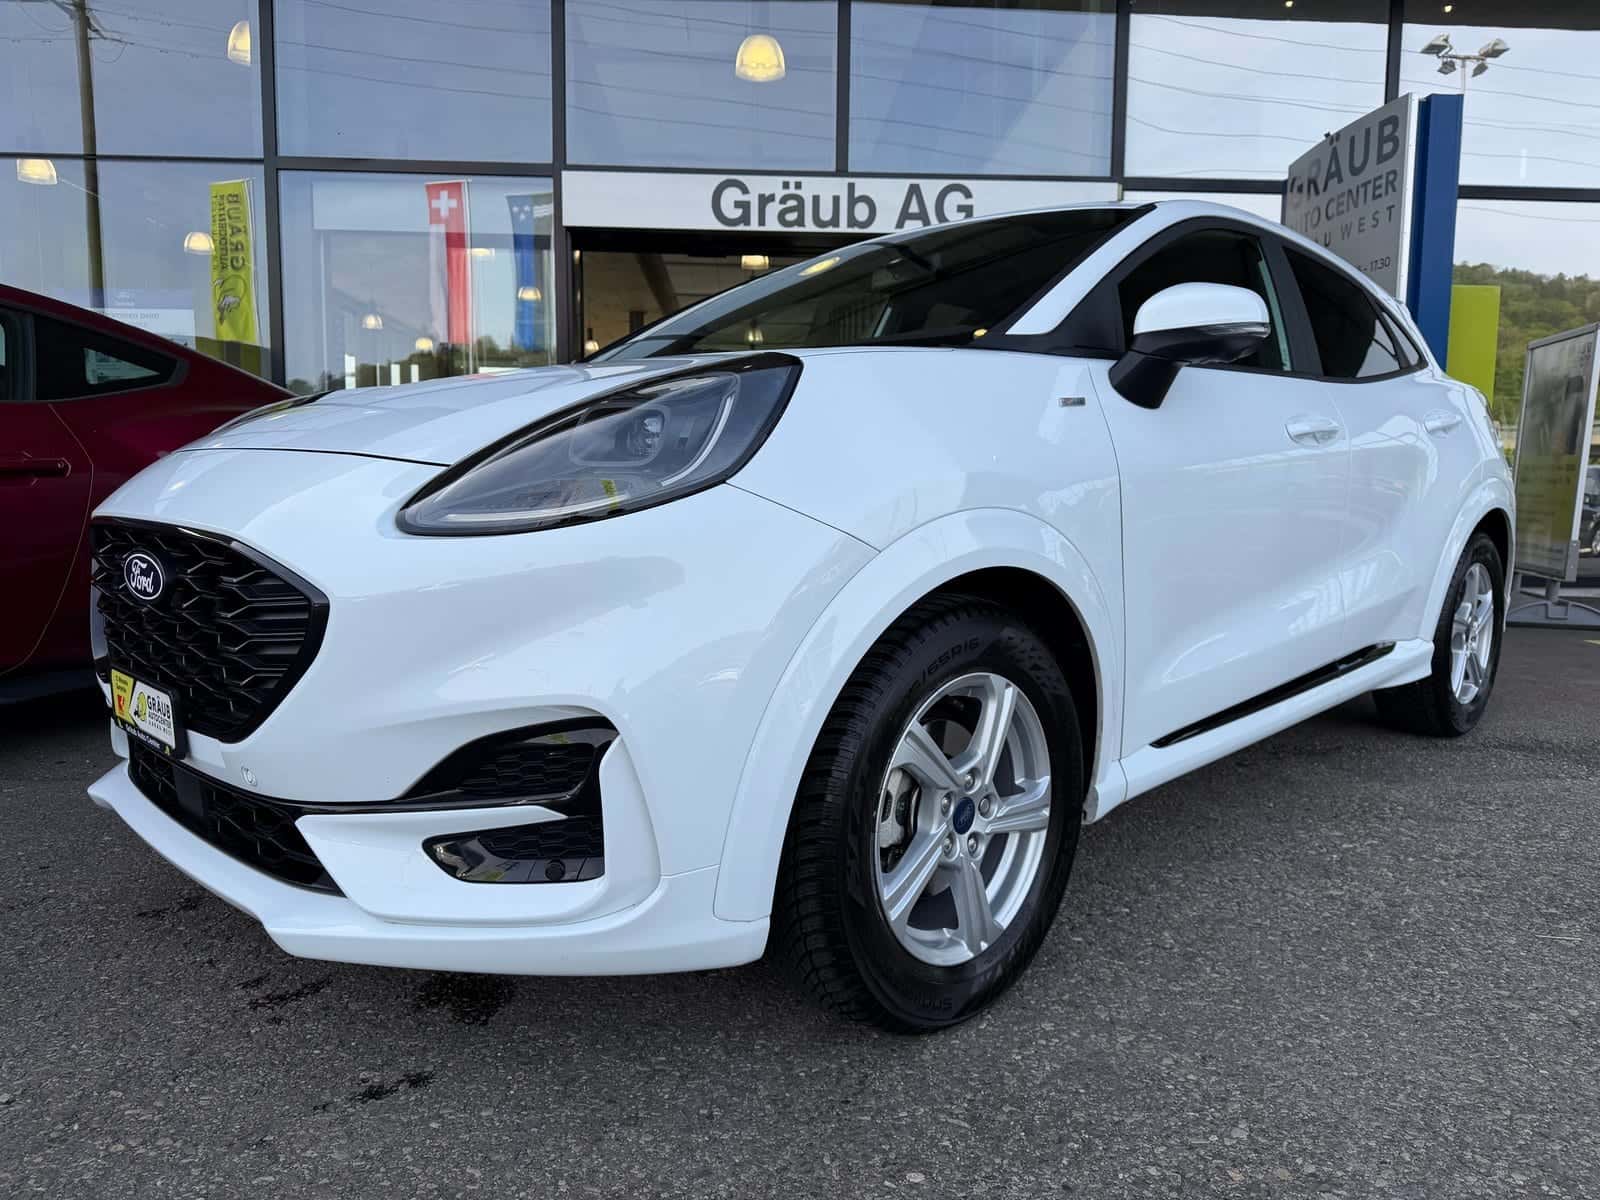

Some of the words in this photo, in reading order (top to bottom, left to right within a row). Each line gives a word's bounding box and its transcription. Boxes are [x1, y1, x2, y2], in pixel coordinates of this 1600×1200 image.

[711, 178, 877, 229] Gräub
[894, 183, 974, 230] AG
[1340, 204, 1396, 240] WEST
[130, 558, 155, 594] Ford
[147, 695, 171, 719] GRÄUB
